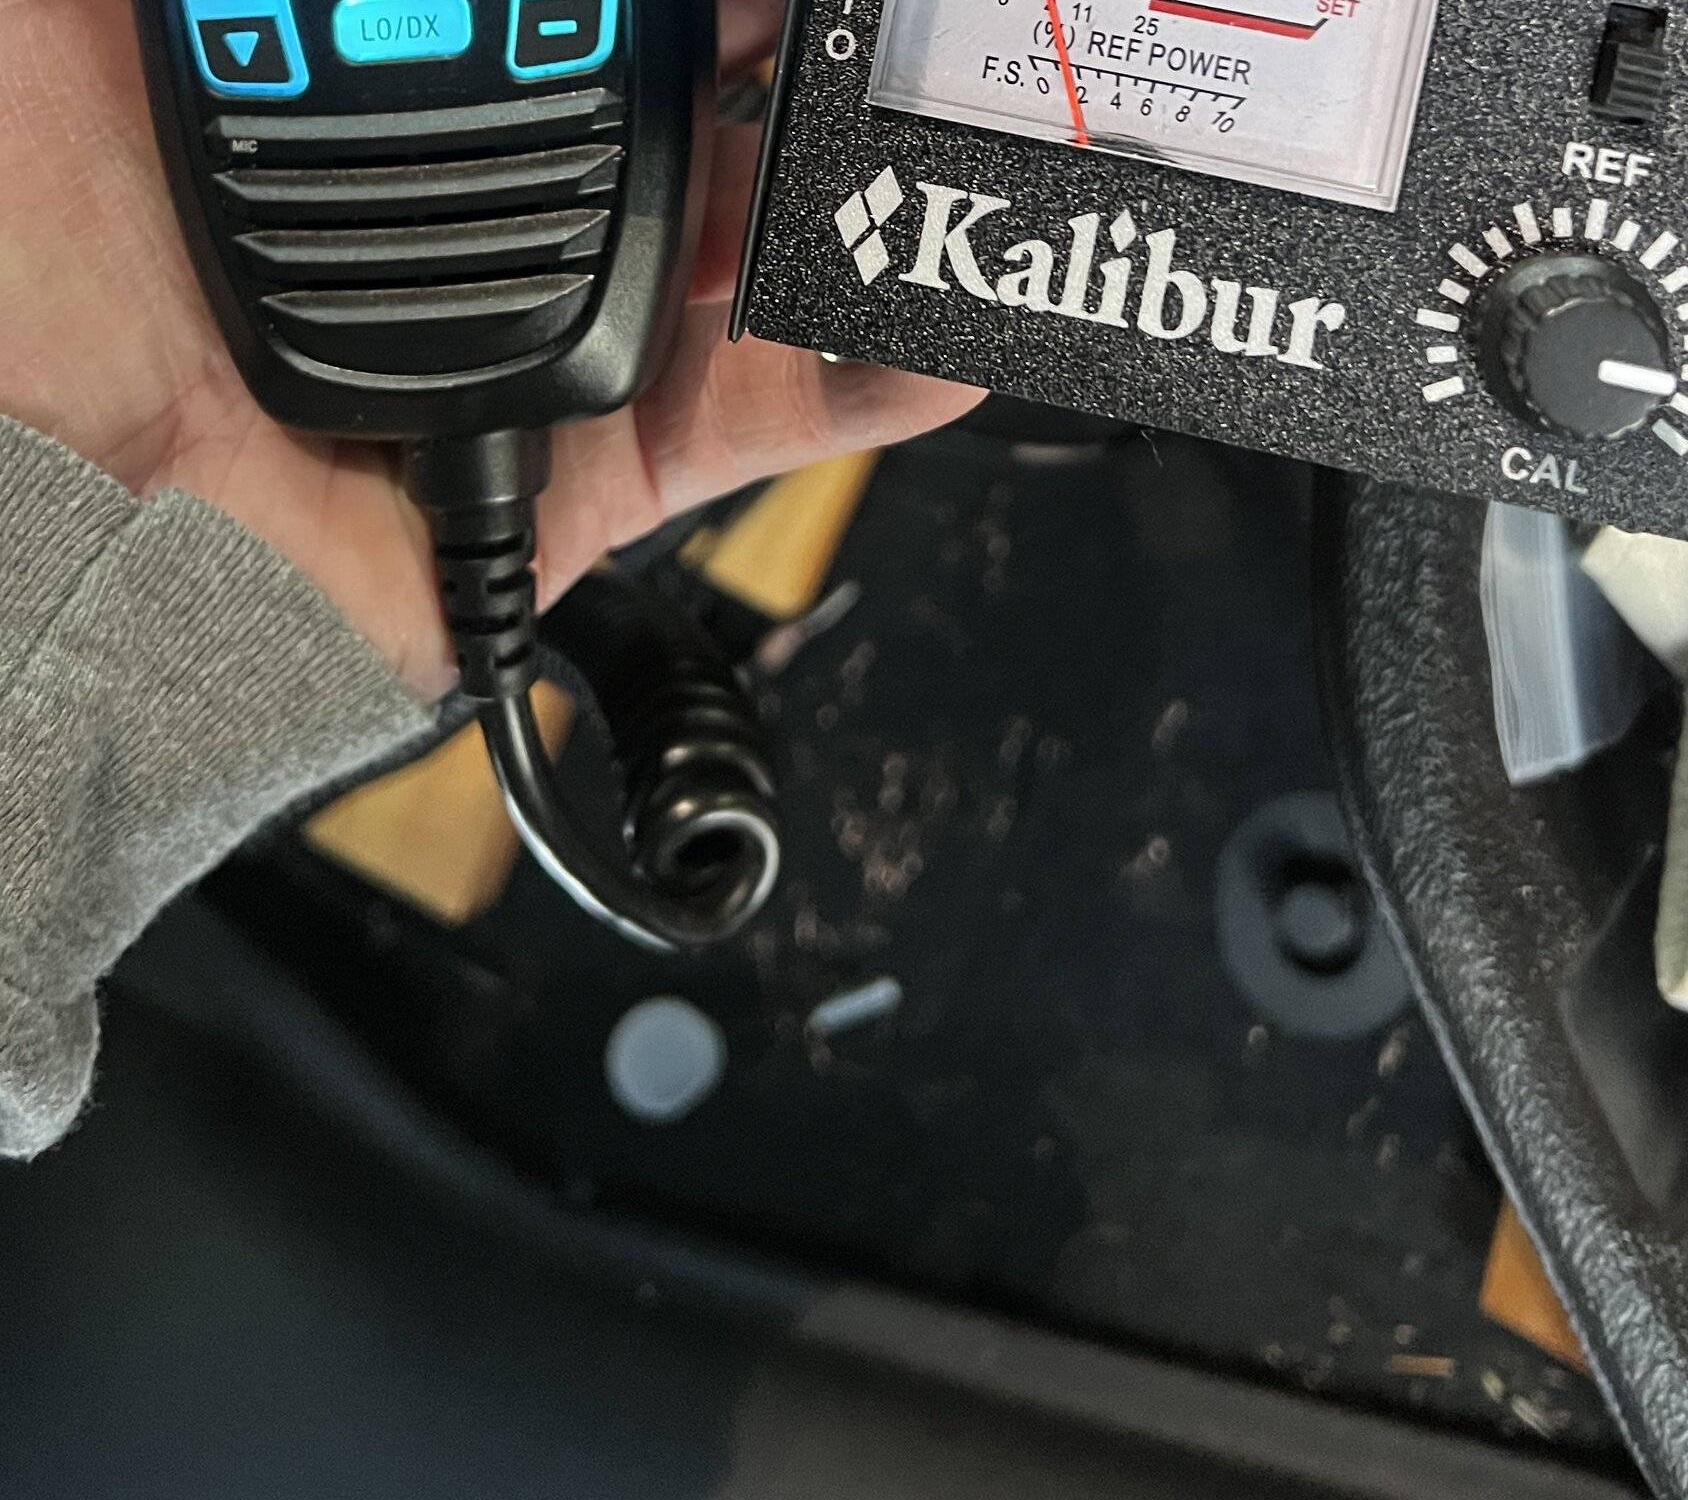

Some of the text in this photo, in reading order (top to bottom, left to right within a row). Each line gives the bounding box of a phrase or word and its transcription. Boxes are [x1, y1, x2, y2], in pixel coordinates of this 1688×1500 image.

[360, 15, 441, 43] LO/DX
[1072, 2, 1093, 23] 11
[1133, 15, 1160, 36] 25
[982, 55, 1025, 87] F.S.
[1087, 30, 1144, 62] REF
[1147, 42, 1252, 85] POWER
[1036, 76, 1235, 134] 0 2 4 6 8 10
[231, 139, 258, 154] MIC
[1561, 140, 1655, 187] REF
[899, 180, 1346, 371] Kalibur
[1501, 445, 1590, 495] CAL
